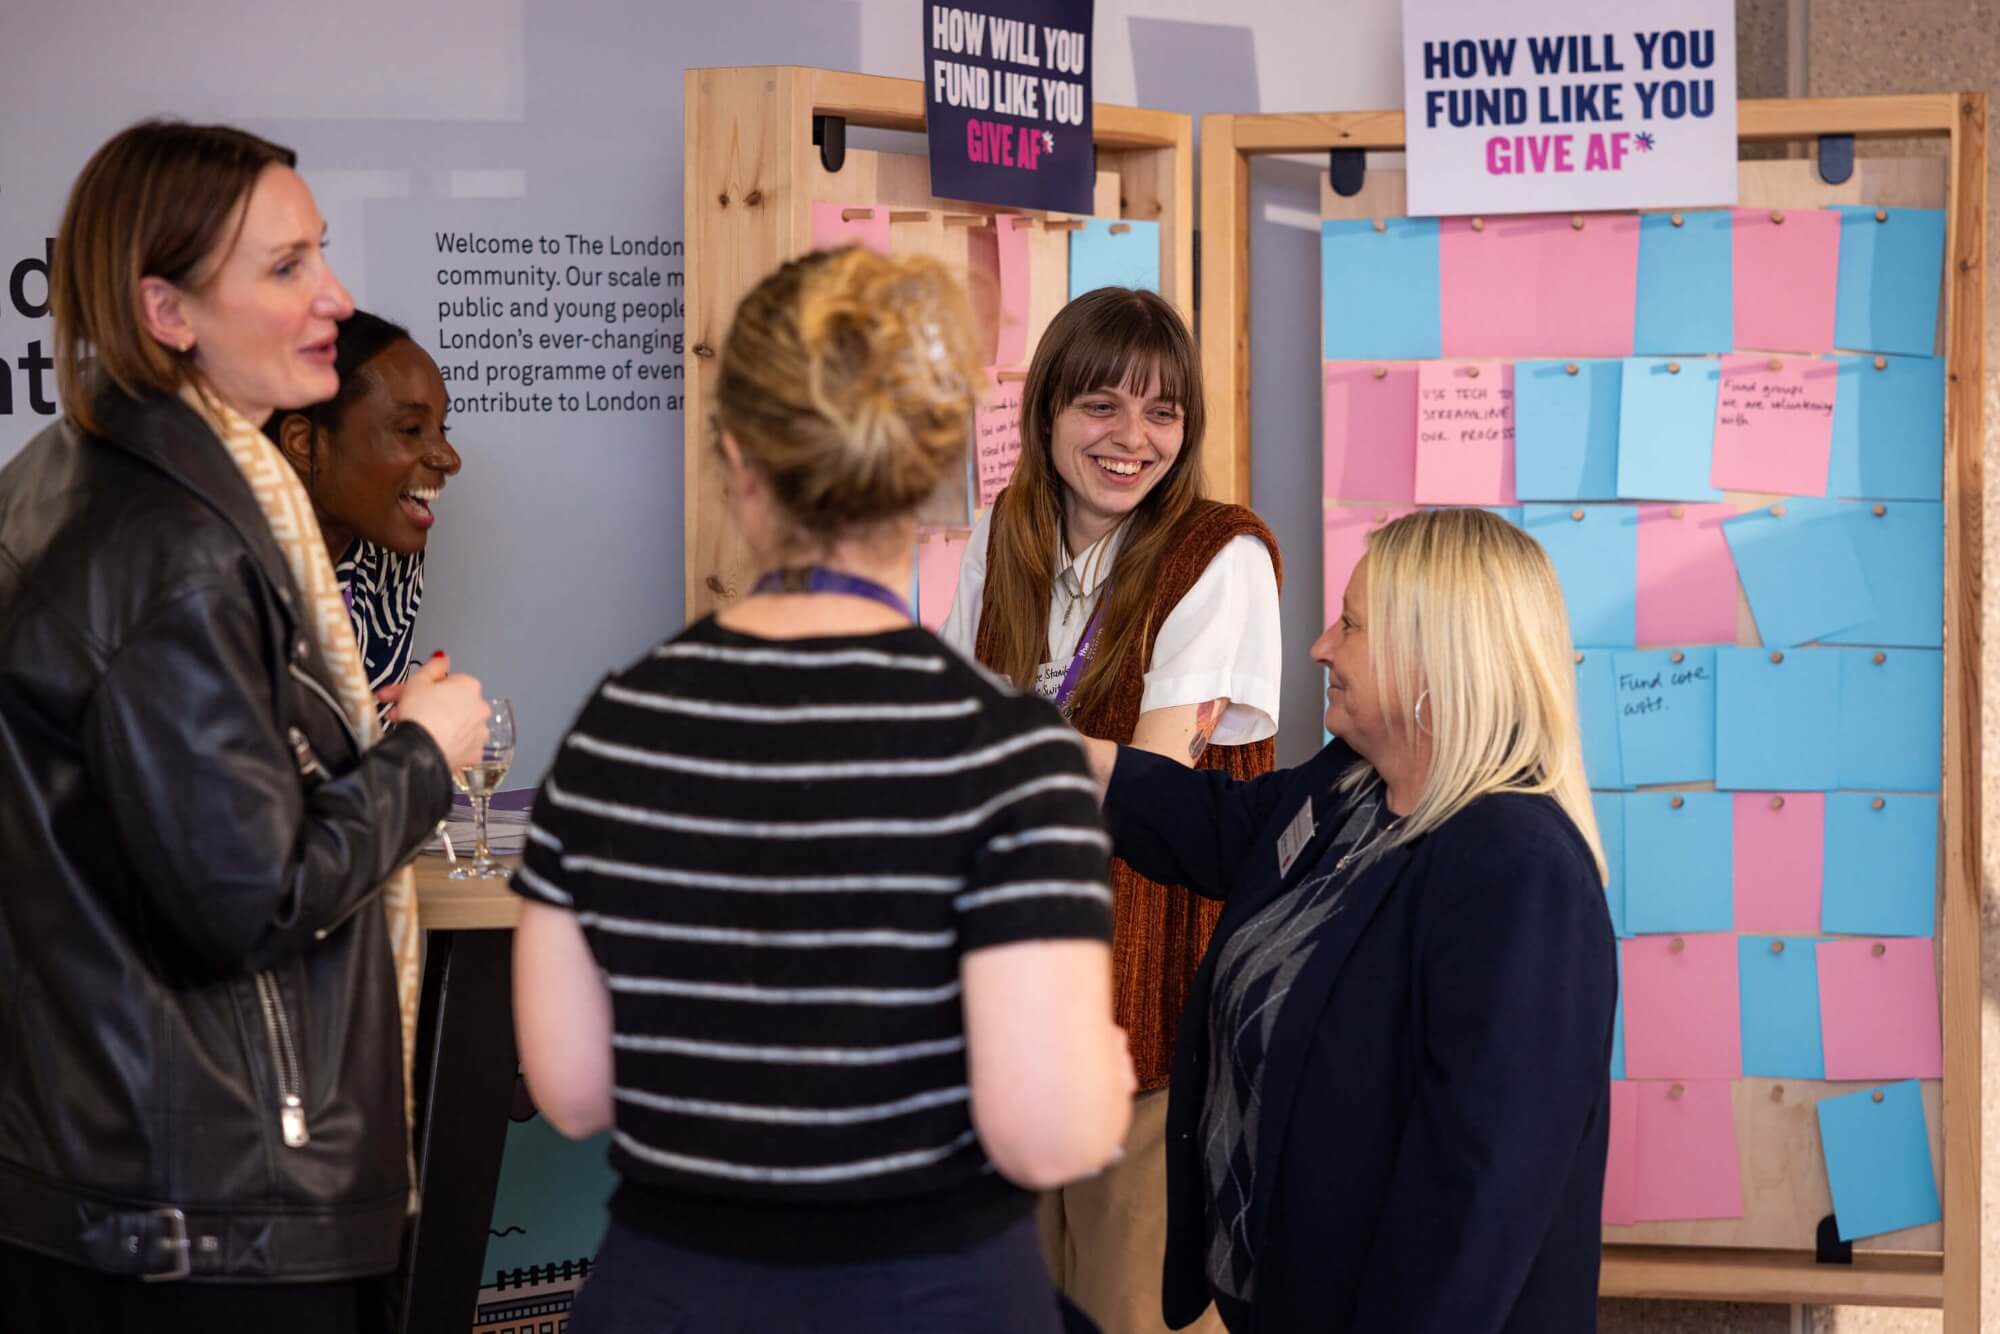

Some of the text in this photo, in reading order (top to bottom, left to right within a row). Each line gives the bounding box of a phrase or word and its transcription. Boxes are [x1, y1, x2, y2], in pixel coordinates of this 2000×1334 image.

[932, 5, 1085, 75] HOW WILL YOU
[1423, 29, 1714, 79] HOW WILL YOU
[933, 59, 1084, 126] FUND LIKE YOU
[1426, 79, 1714, 128] FUND LIKE YOU
[966, 118, 1014, 168] GIVE
[1485, 134, 1574, 175] GIVE
[435, 232, 684, 256] Welcome to The London
[437, 265, 560, 291] community.
[566, 265, 603, 286] Our
[608, 266, 661, 287] scale
[438, 296, 504, 323] public
[510, 297, 549, 318] and
[554, 302, 617, 323] young
[440, 327, 684, 354] London’s ever-changing
[441, 360, 479, 381] and
[486, 363, 606, 386] programme
[612, 359, 632, 380] of
[558, 393, 579, 412] to
[586, 390, 661, 411] London
[1456, 388, 1488, 400] TECH
[1422, 406, 1510, 420] STREAMLINE
[1620, 672, 1662, 691] Fund
